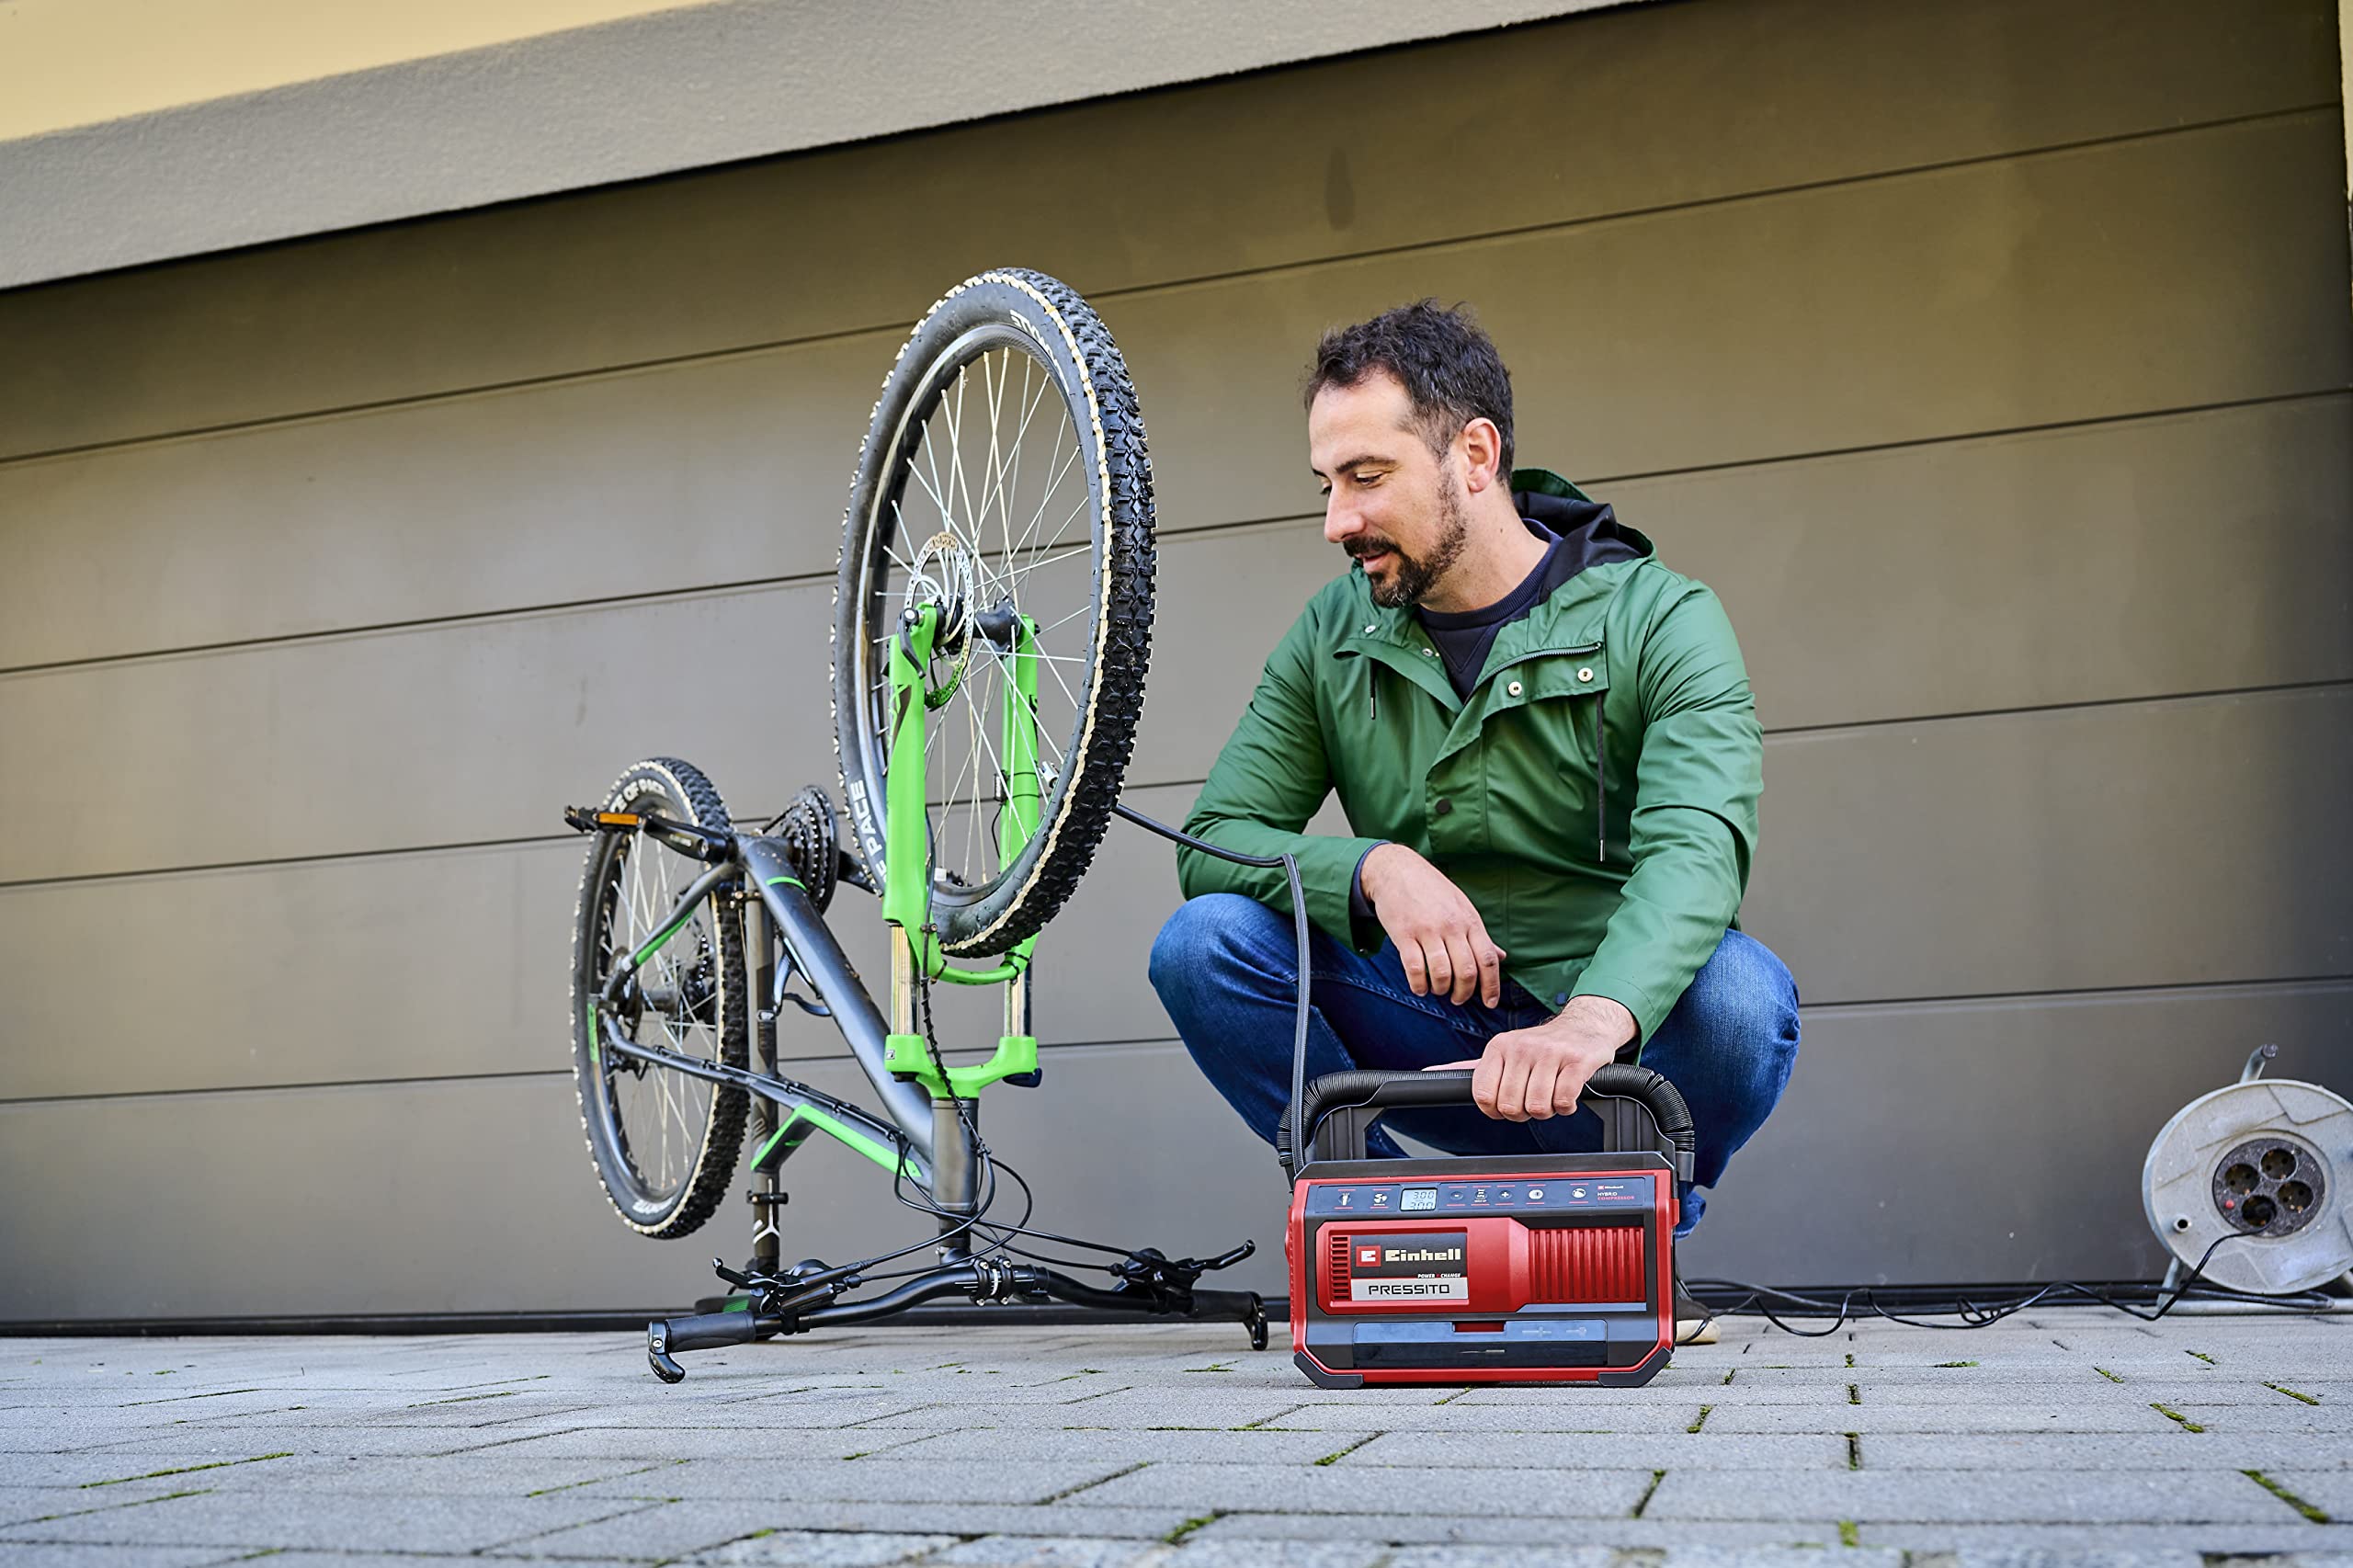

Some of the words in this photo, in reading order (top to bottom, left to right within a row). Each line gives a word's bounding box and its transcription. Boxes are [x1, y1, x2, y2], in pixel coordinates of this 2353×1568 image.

[850, 779, 882, 857] PACE
[1385, 1248, 1461, 1262] Einhell
[1368, 1285, 1450, 1295] PRESSITO
